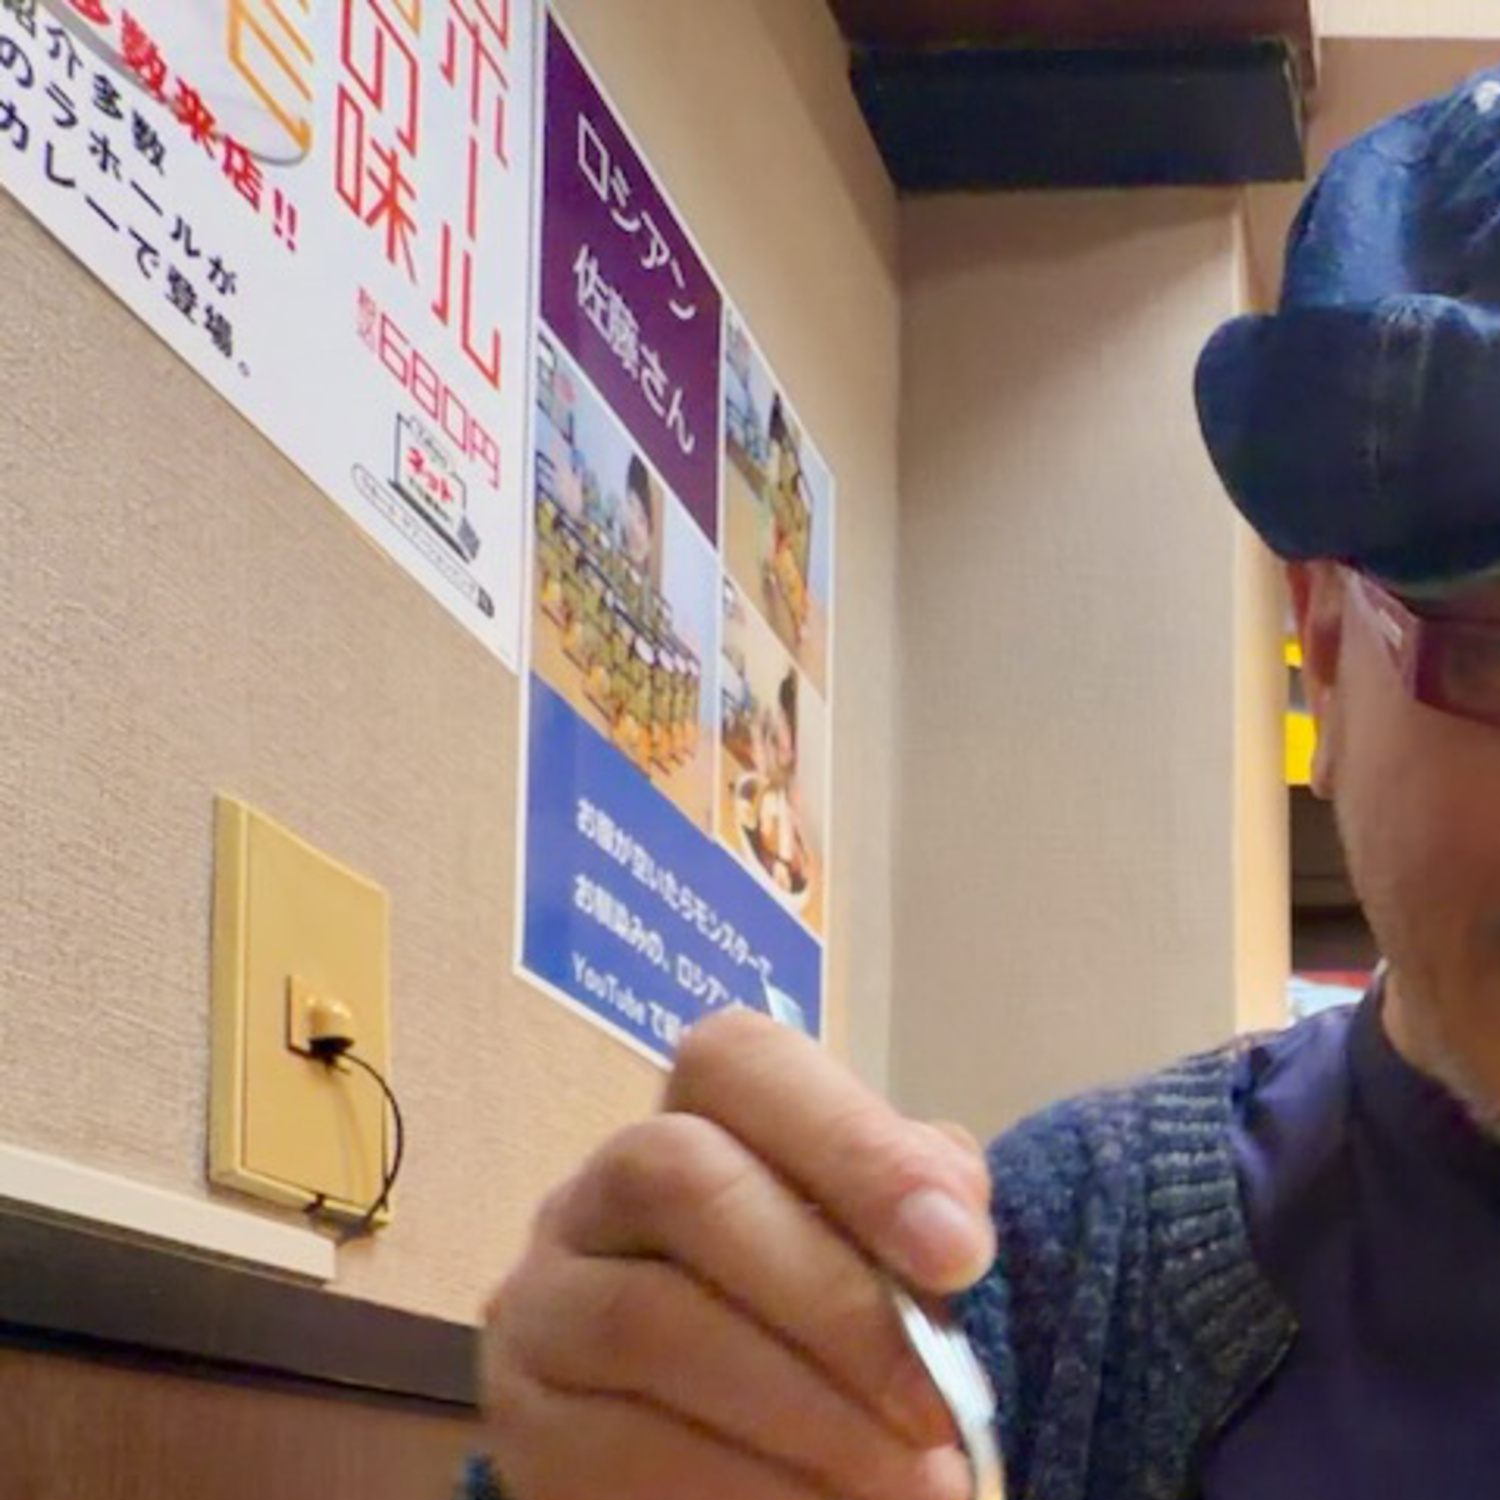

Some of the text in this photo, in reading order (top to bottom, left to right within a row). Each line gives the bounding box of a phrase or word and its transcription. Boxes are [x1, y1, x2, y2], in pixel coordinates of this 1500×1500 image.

[434, 0, 509, 391] ホール
[577, 112, 697, 321] ロシアン
[573, 243, 696, 455] 佐藤さん
